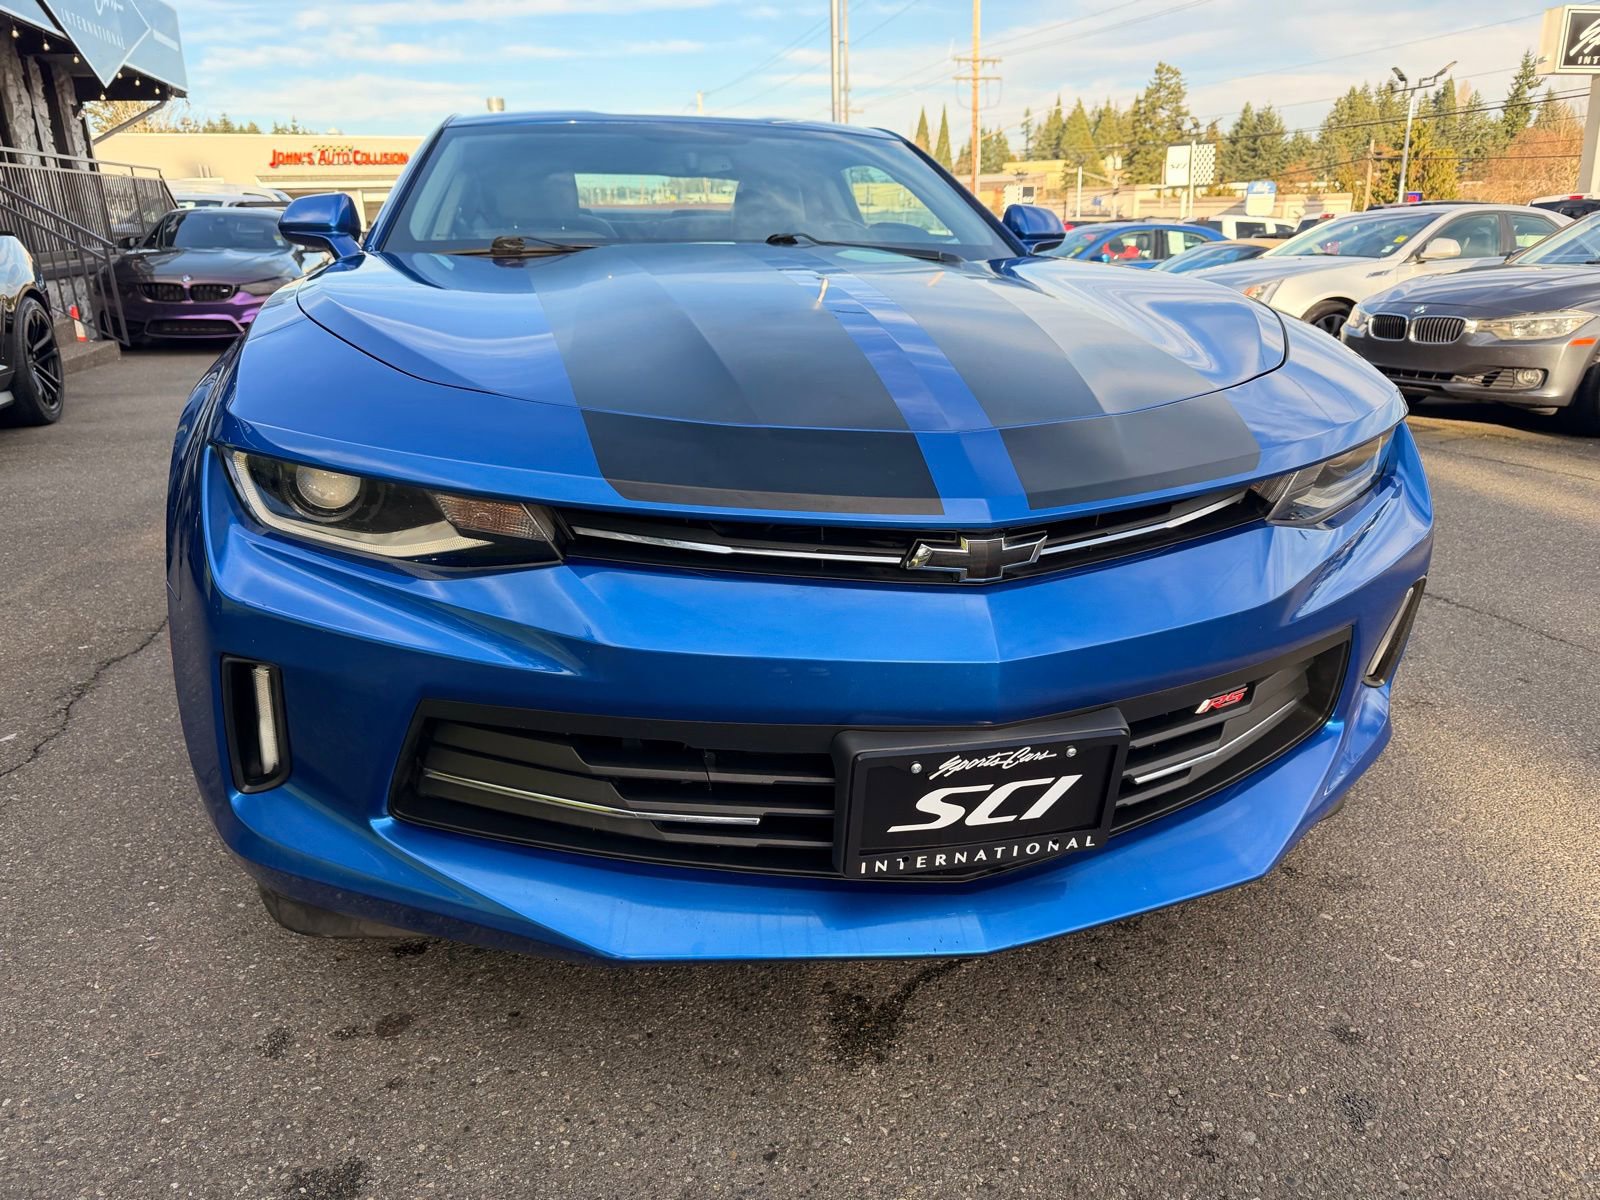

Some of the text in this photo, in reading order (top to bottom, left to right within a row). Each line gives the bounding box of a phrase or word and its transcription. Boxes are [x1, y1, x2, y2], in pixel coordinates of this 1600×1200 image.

[1195, 687, 1249, 714] RS
[928, 746, 1057, 780] Sports Cars
[887, 774, 1083, 833] SCI
[860, 835, 1096, 874] INTERNATIONAL
